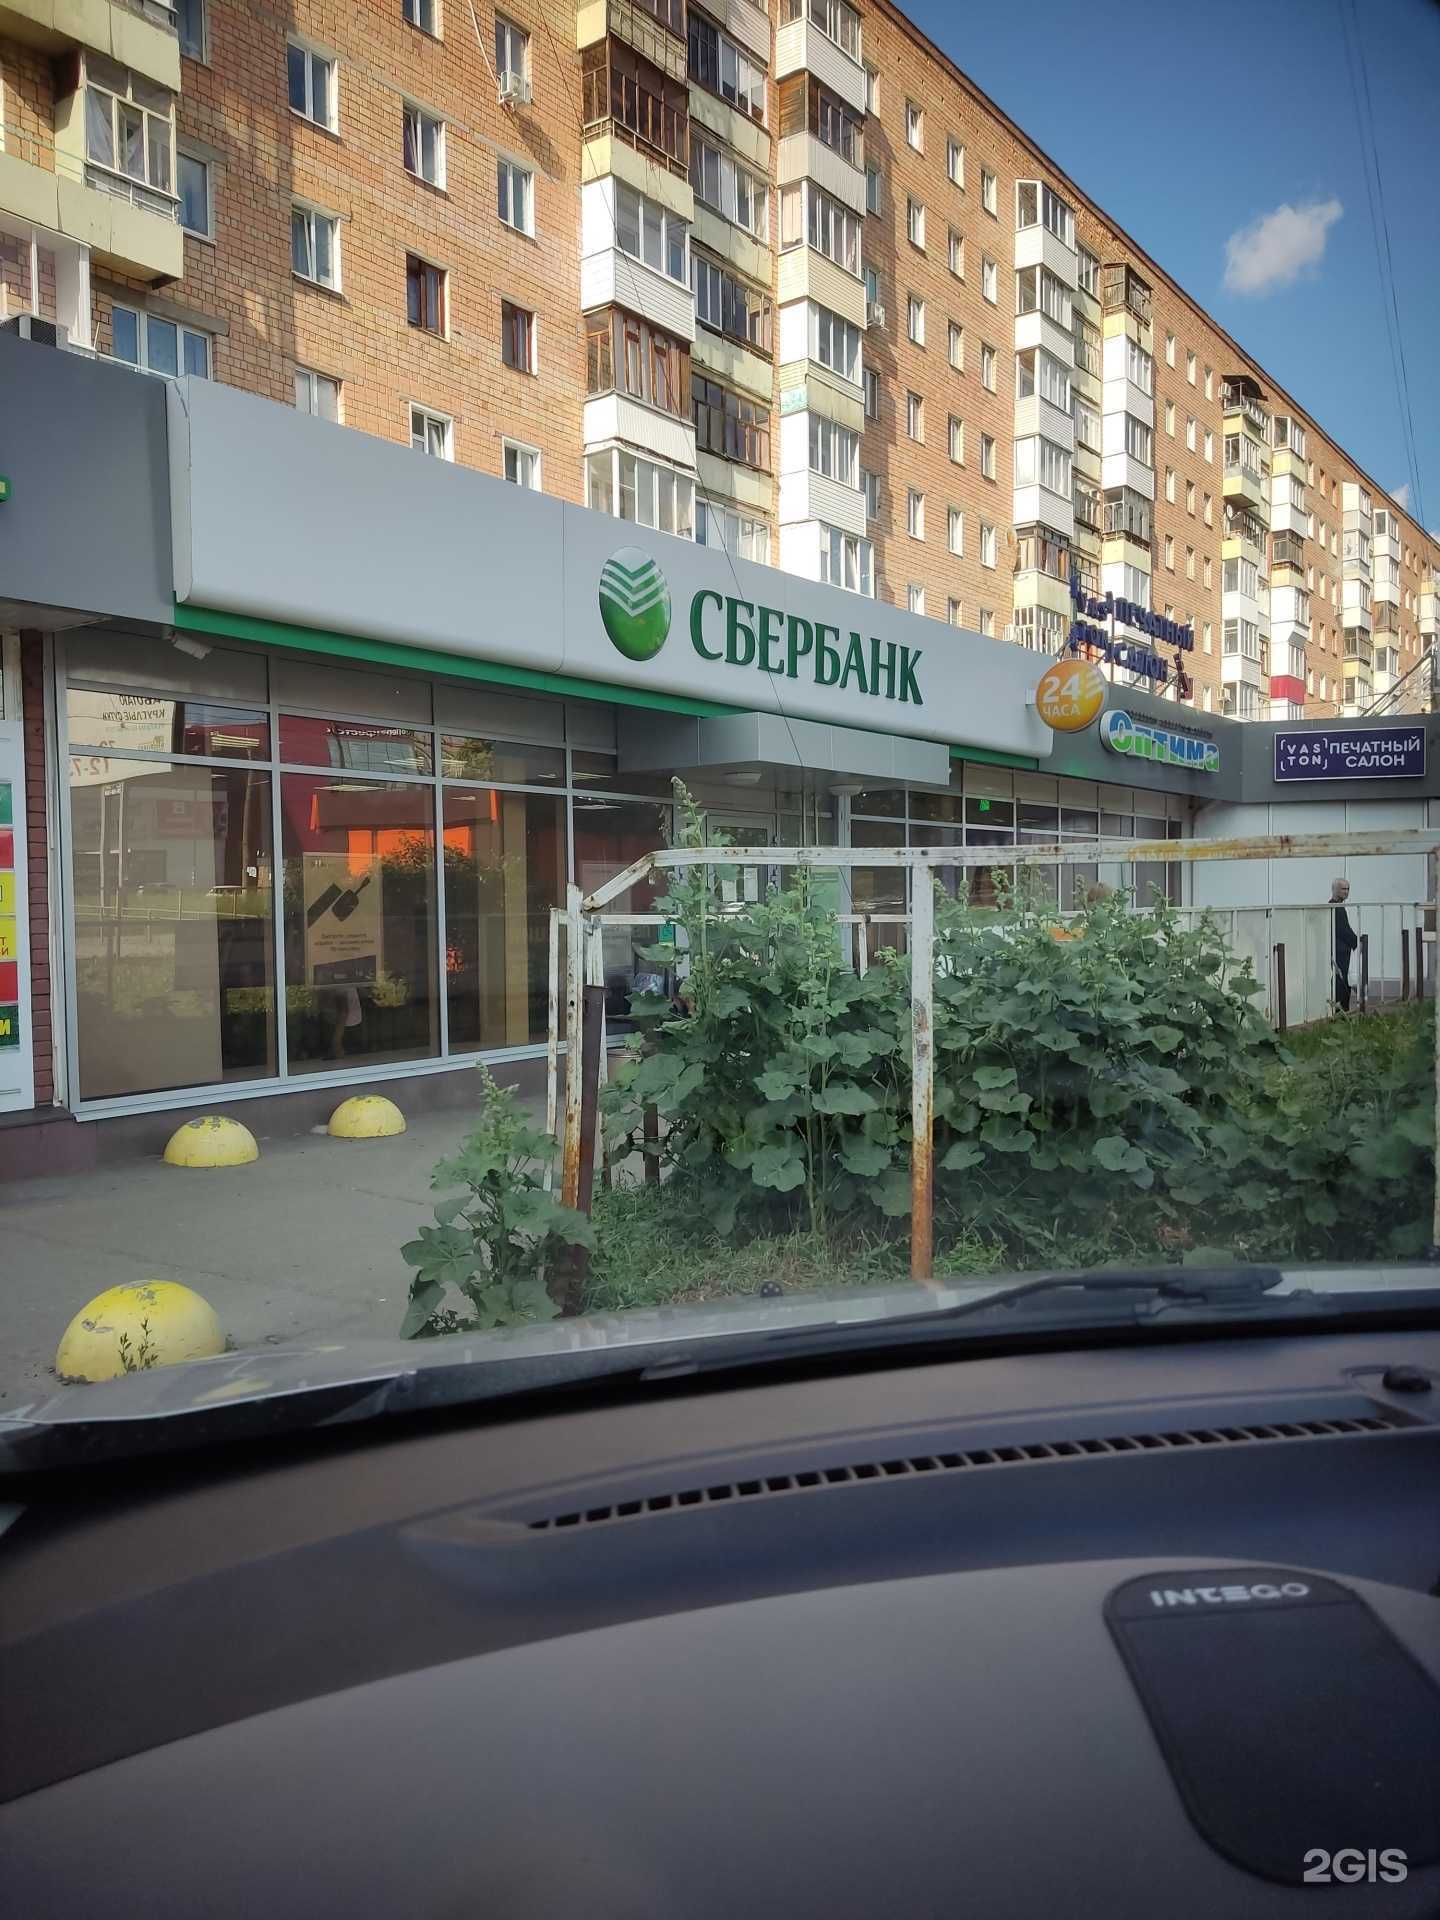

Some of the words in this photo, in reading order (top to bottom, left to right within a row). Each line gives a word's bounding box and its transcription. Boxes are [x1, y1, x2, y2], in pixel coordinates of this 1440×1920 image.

[689, 589, 924, 706] СБЕРБАНК
[1042, 671, 1081, 704] 24
[1042, 703, 1081, 719] ЧАСА
[1102, 709, 1220, 772] Оптима
[1286, 743, 1321, 755] VAS
[1329, 735, 1421, 755] ПЕЧАТНЫЙ
[1286, 755, 1322, 767] TON
[1345, 754, 1406, 768] САЛОН
[1149, 1581, 1310, 1608] INTEGO
